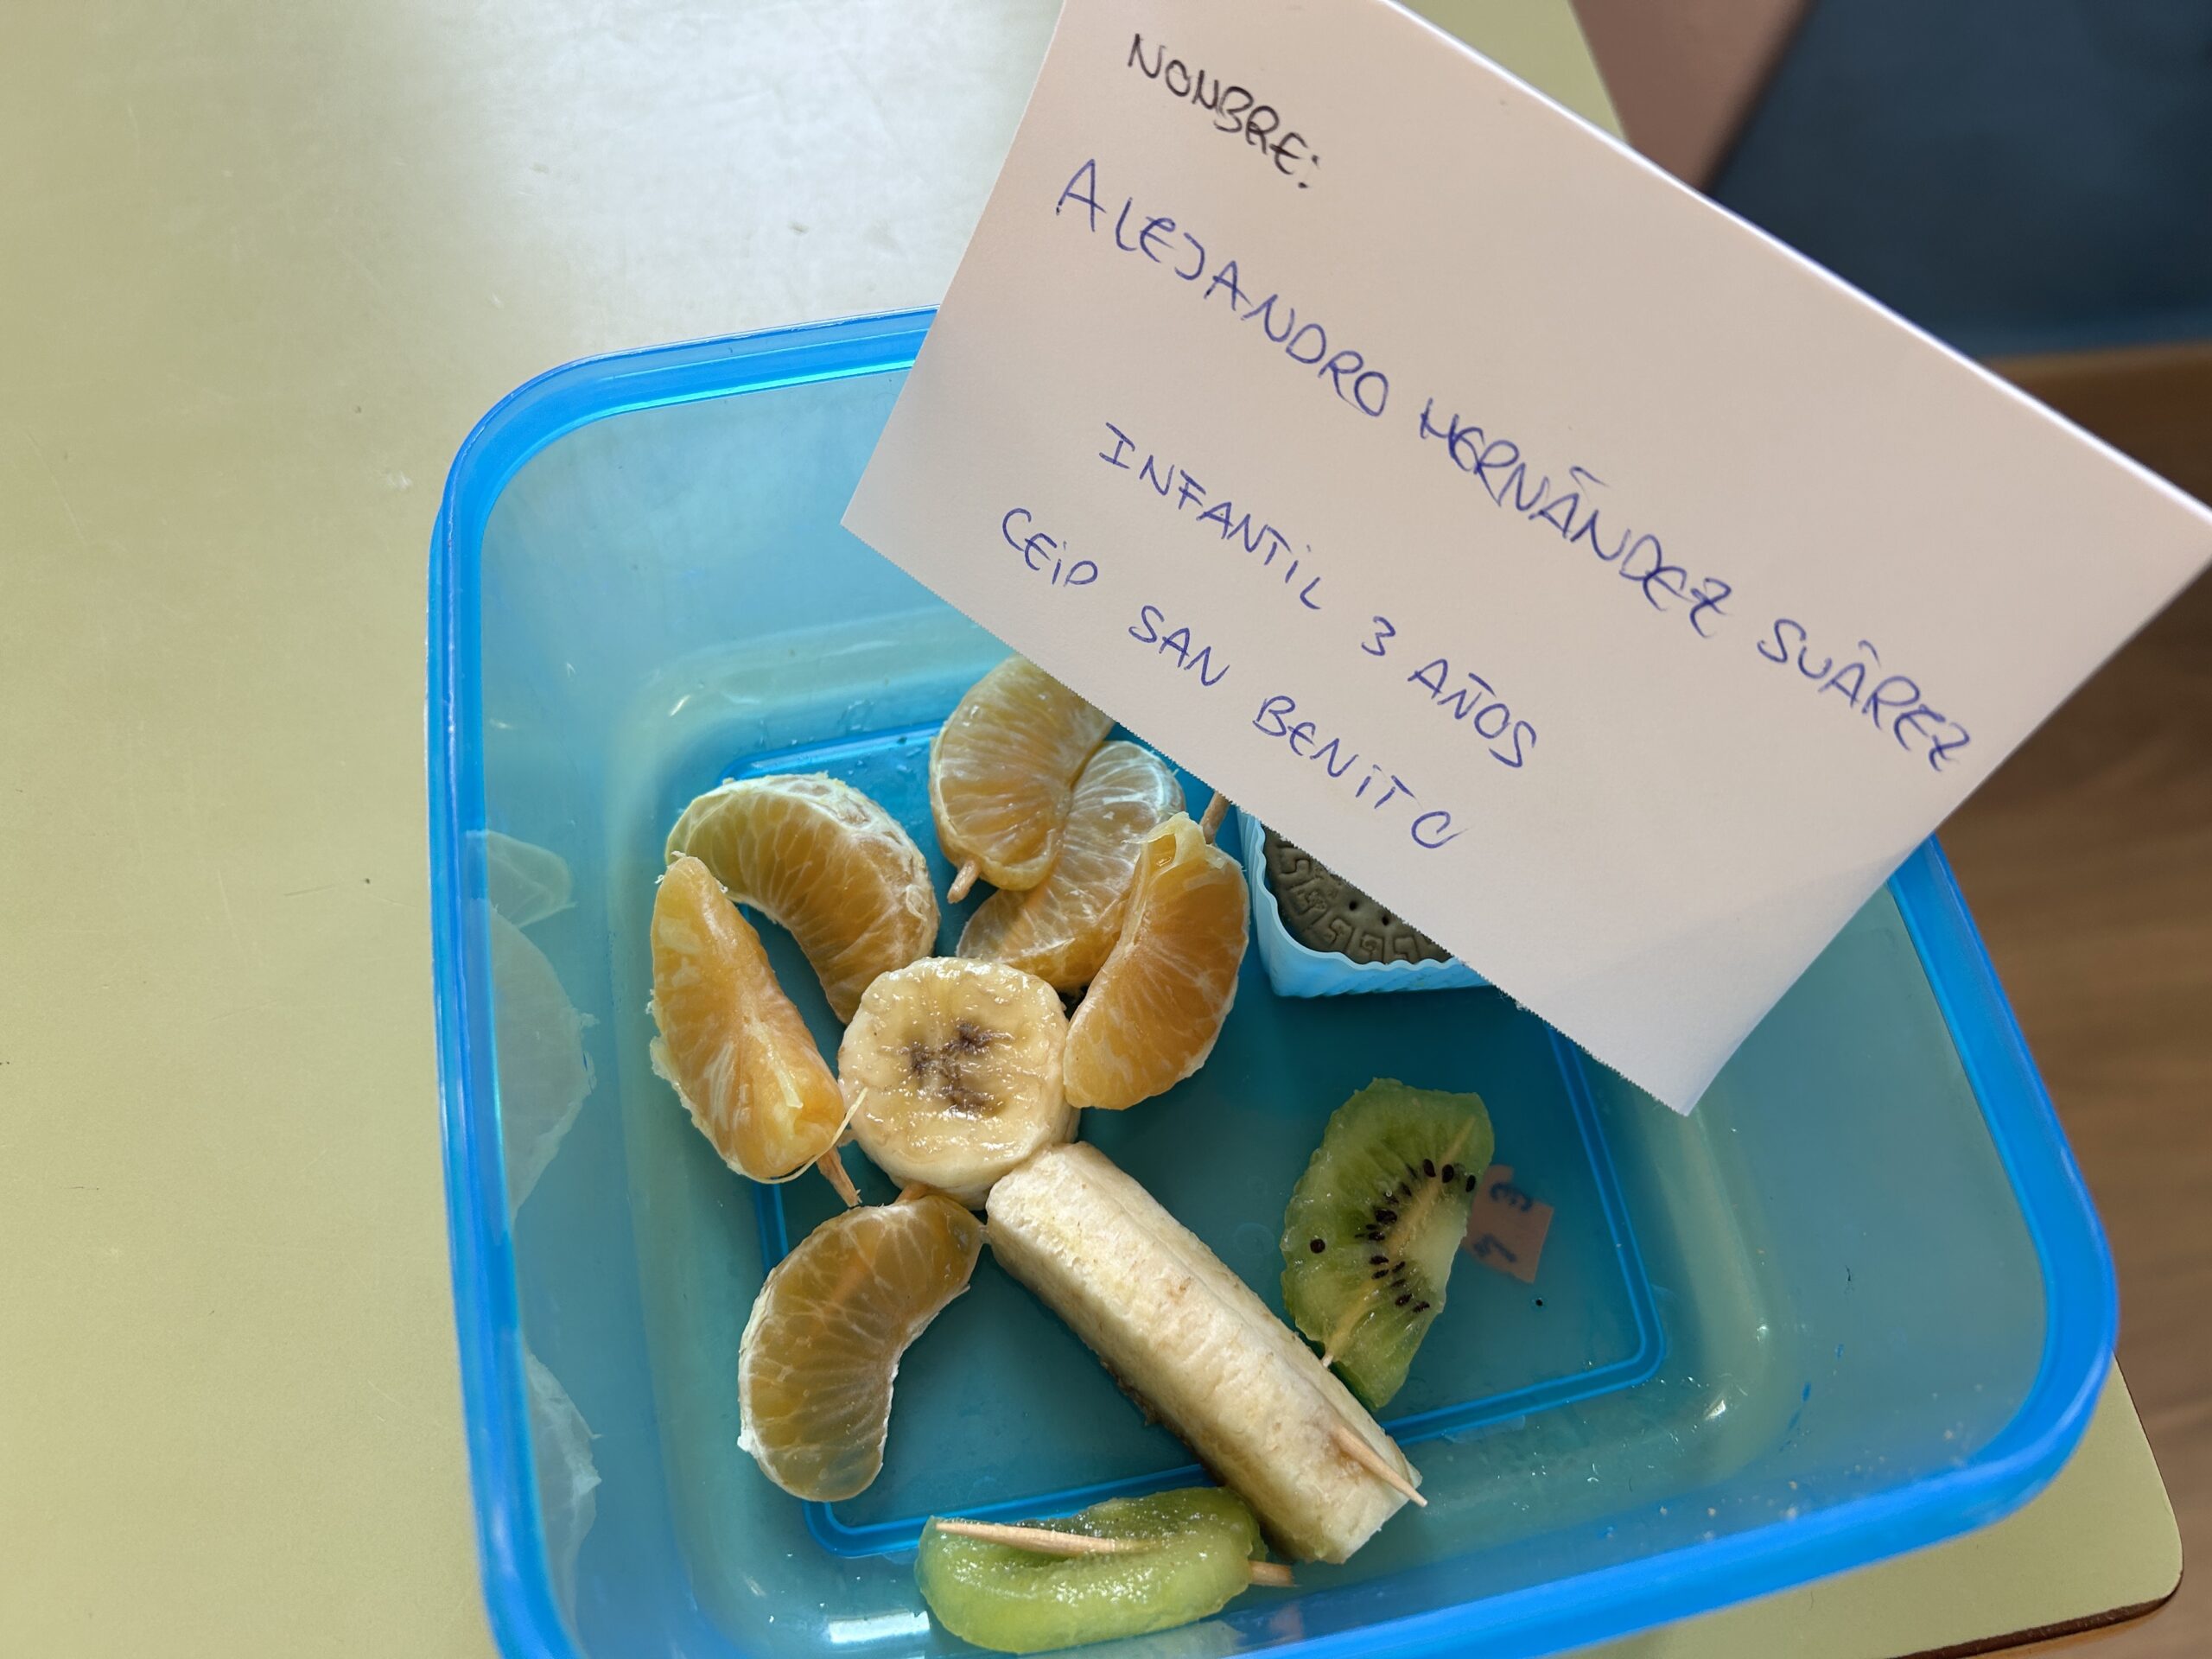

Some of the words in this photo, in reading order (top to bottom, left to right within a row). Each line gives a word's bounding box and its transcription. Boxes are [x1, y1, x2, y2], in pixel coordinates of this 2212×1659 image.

[1056, 158, 1389, 417] ALEJANDRO
[1419, 397, 1732, 638] HERNÁNDEZ
[1756, 618, 1971, 772] SUÁREZ
[1127, 605, 1230, 687] SAN
[1360, 616, 1397, 657] 3
[1407, 658, 1538, 769] AÑOS
